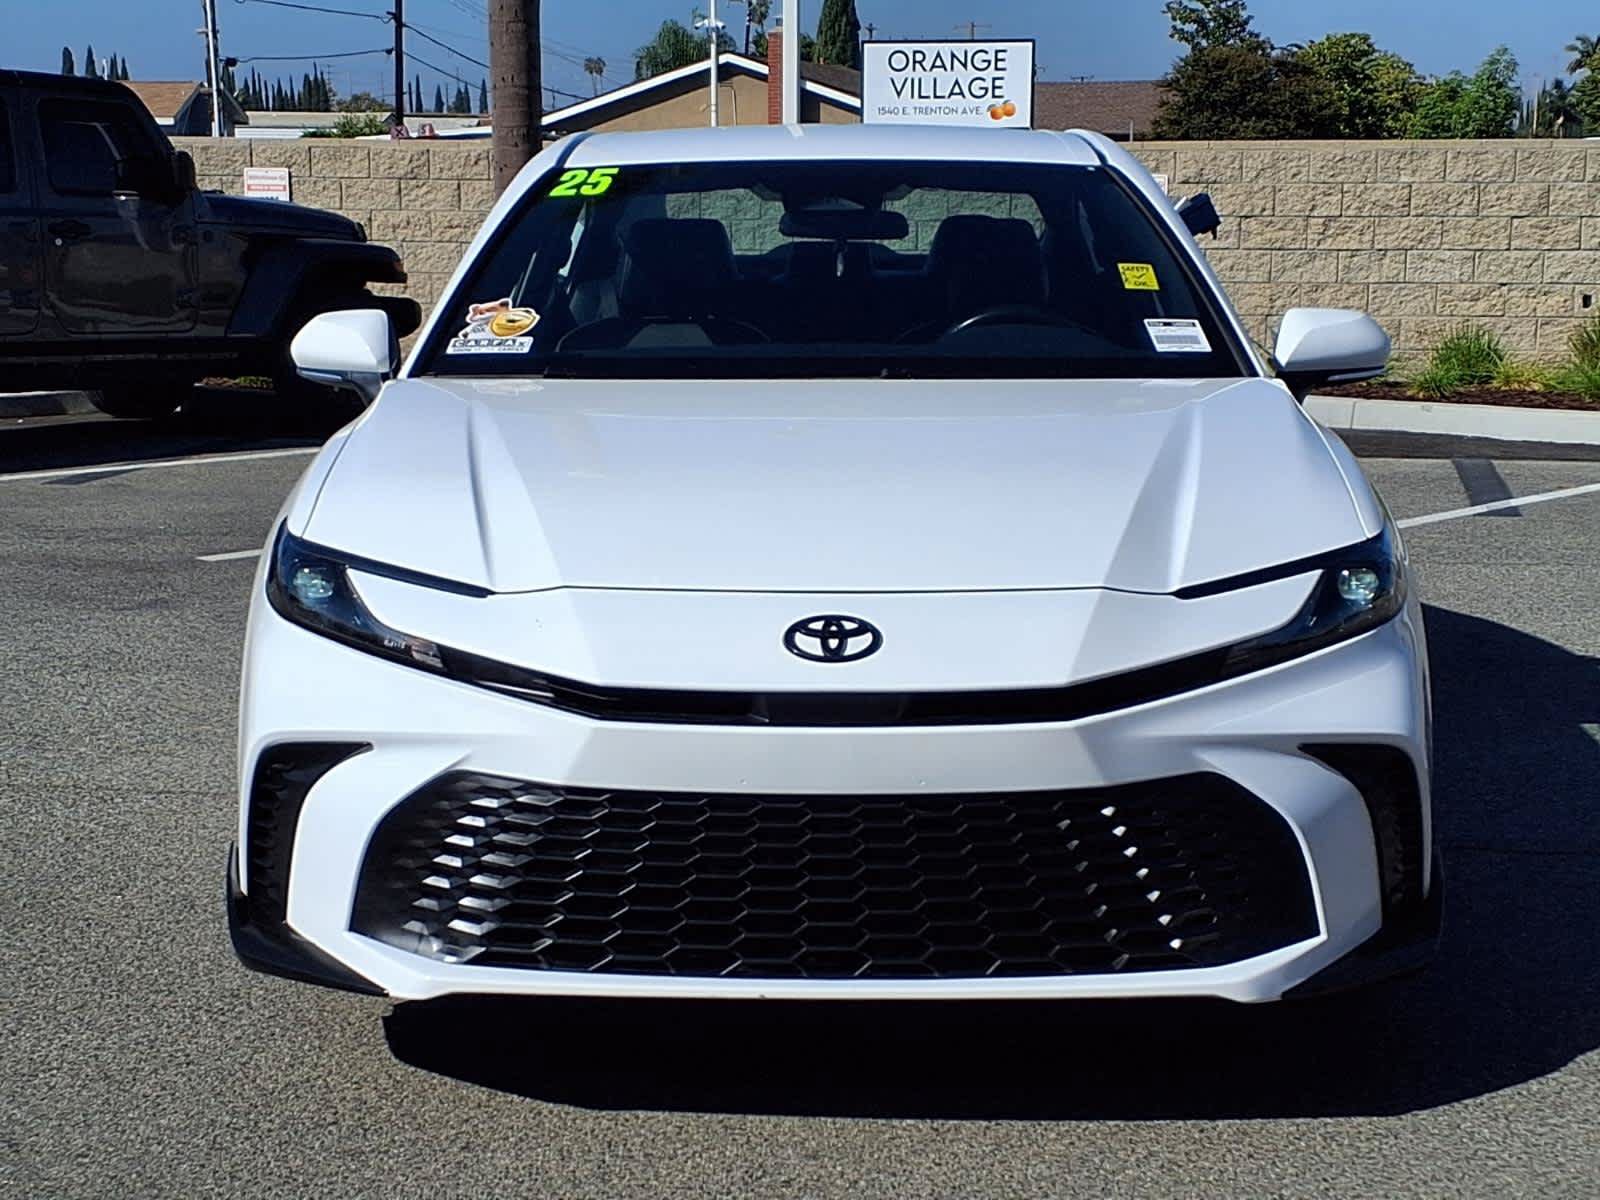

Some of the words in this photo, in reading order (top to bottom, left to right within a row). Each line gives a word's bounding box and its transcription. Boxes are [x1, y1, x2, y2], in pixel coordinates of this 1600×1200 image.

[888, 49, 1008, 73] ORANGE
[890, 76, 1005, 99] VILLAGE
[877, 106, 899, 116] 1540
[913, 106, 959, 116] TRENTON
[961, 106, 983, 116] AVE.
[549, 167, 620, 197] 25
